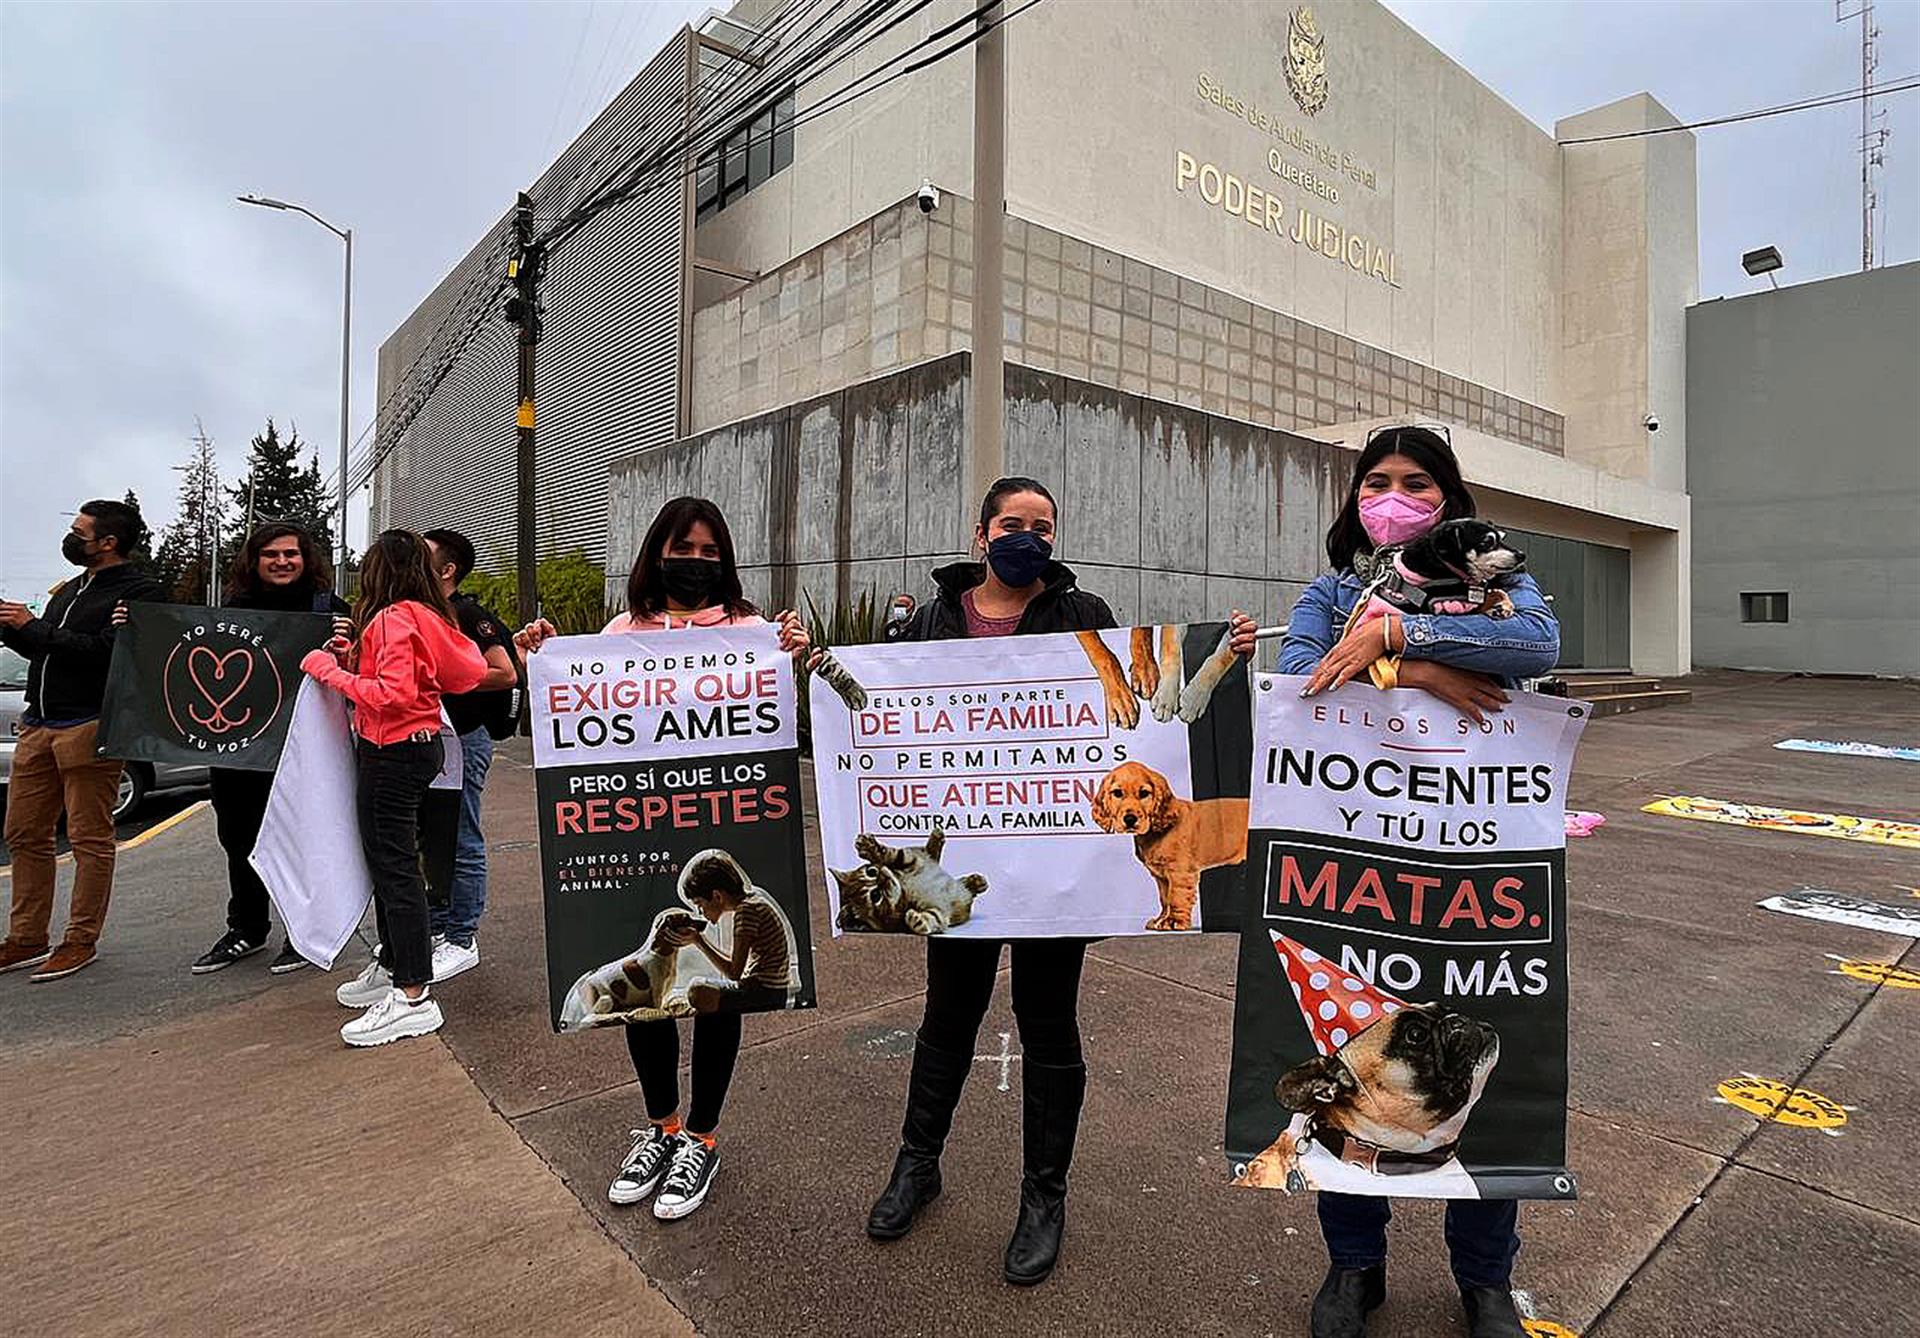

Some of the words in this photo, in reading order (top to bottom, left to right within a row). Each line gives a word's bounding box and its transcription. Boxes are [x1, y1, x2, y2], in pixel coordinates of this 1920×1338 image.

[1198, 72, 1245, 118] Salas
[1248, 103, 1267, 131] de
[1341, 151, 1378, 190] Penal
[1267, 148, 1339, 203] Querétaro
[1175, 150, 1283, 236] PODER
[1290, 208, 1402, 289] JUDICIAL
[182, 625, 206, 642] YO
[216, 621, 264, 648] SERÉ
[570, 662, 604, 677] NO
[625, 651, 756, 673] PODEMOS
[549, 677, 677, 713] EXIGIR
[694, 668, 778, 702] QUE
[873, 695, 935, 709] ELLOS
[949, 692, 988, 705] SON
[1002, 688, 1066, 702] PARTE
[551, 713, 636, 749] LOS
[653, 701, 781, 743] AMES
[860, 711, 901, 736] DE
[914, 709, 954, 734] LA
[967, 702, 1099, 732] FAMILIA
[1313, 704, 1430, 735] ELLOS
[1457, 717, 1516, 735] SON
[187, 734, 208, 750] TU
[216, 737, 250, 754] VOZ
[837, 753, 875, 771] NO
[897, 744, 1128, 770] PERMITAMOS
[569, 773, 627, 794] PERO
[635, 768, 655, 790] SÍ
[663, 767, 714, 789] QUE
[721, 763, 767, 784] LOS
[1265, 747, 1553, 806] INOCENTES
[866, 783, 929, 808] QUE
[942, 779, 1095, 807] ATENTEN
[554, 784, 790, 836] RESPETES
[878, 812, 960, 831] CONTRA
[966, 813, 994, 830] LA
[1000, 810, 1086, 830] FAMILIA
[1337, 807, 1362, 832] Y
[1376, 811, 1425, 843] TÚ
[1439, 820, 1498, 847] LOS
[559, 869, 577, 880] EL
[588, 863, 679, 878] BIENESTAR
[639, 851, 671, 863] POR
[1278, 854, 1543, 930] MATAS.
[1340, 943, 1422, 993] NO
[1443, 950, 1549, 997] MÁS
